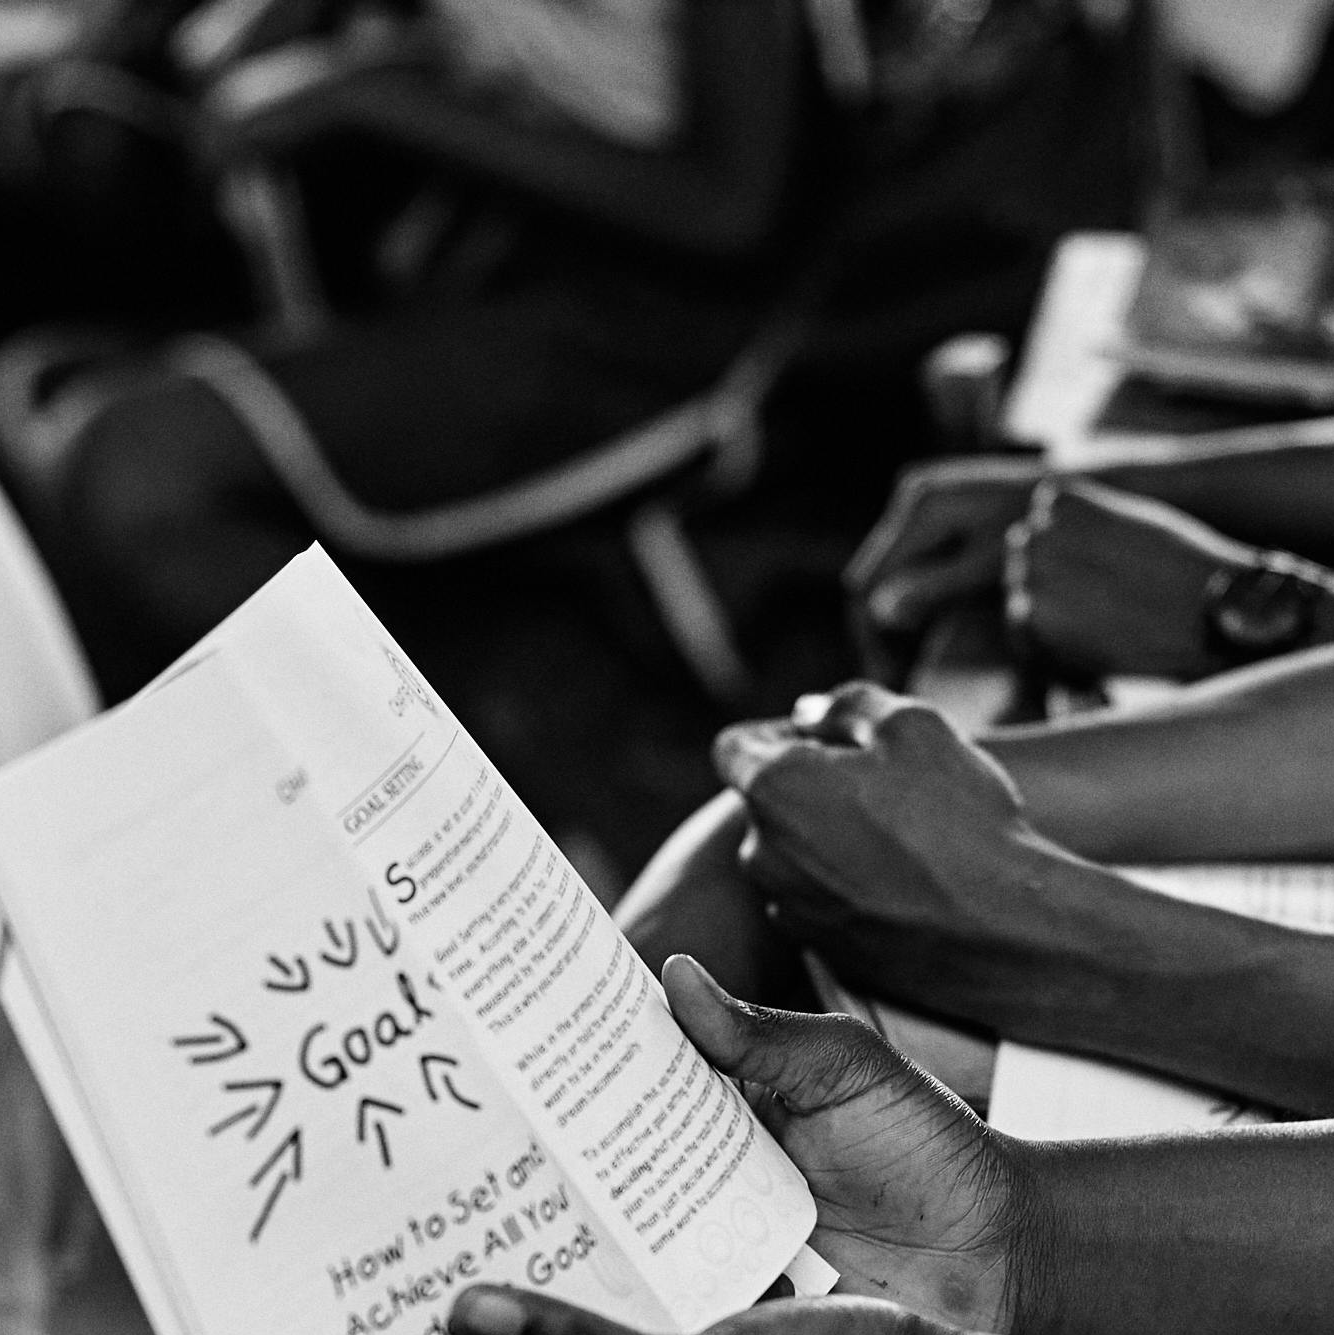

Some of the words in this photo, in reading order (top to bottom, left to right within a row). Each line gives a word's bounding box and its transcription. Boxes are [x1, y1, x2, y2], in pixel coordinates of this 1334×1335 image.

[299, 971, 433, 1088] Goal
[327, 1234, 405, 1298] How
[407, 1213, 447, 1246] to
[447, 1169, 502, 1226] Set
[507, 1139, 547, 1190] and
[609, 1160, 652, 1200] deciding
[483, 1213, 525, 1259] All
